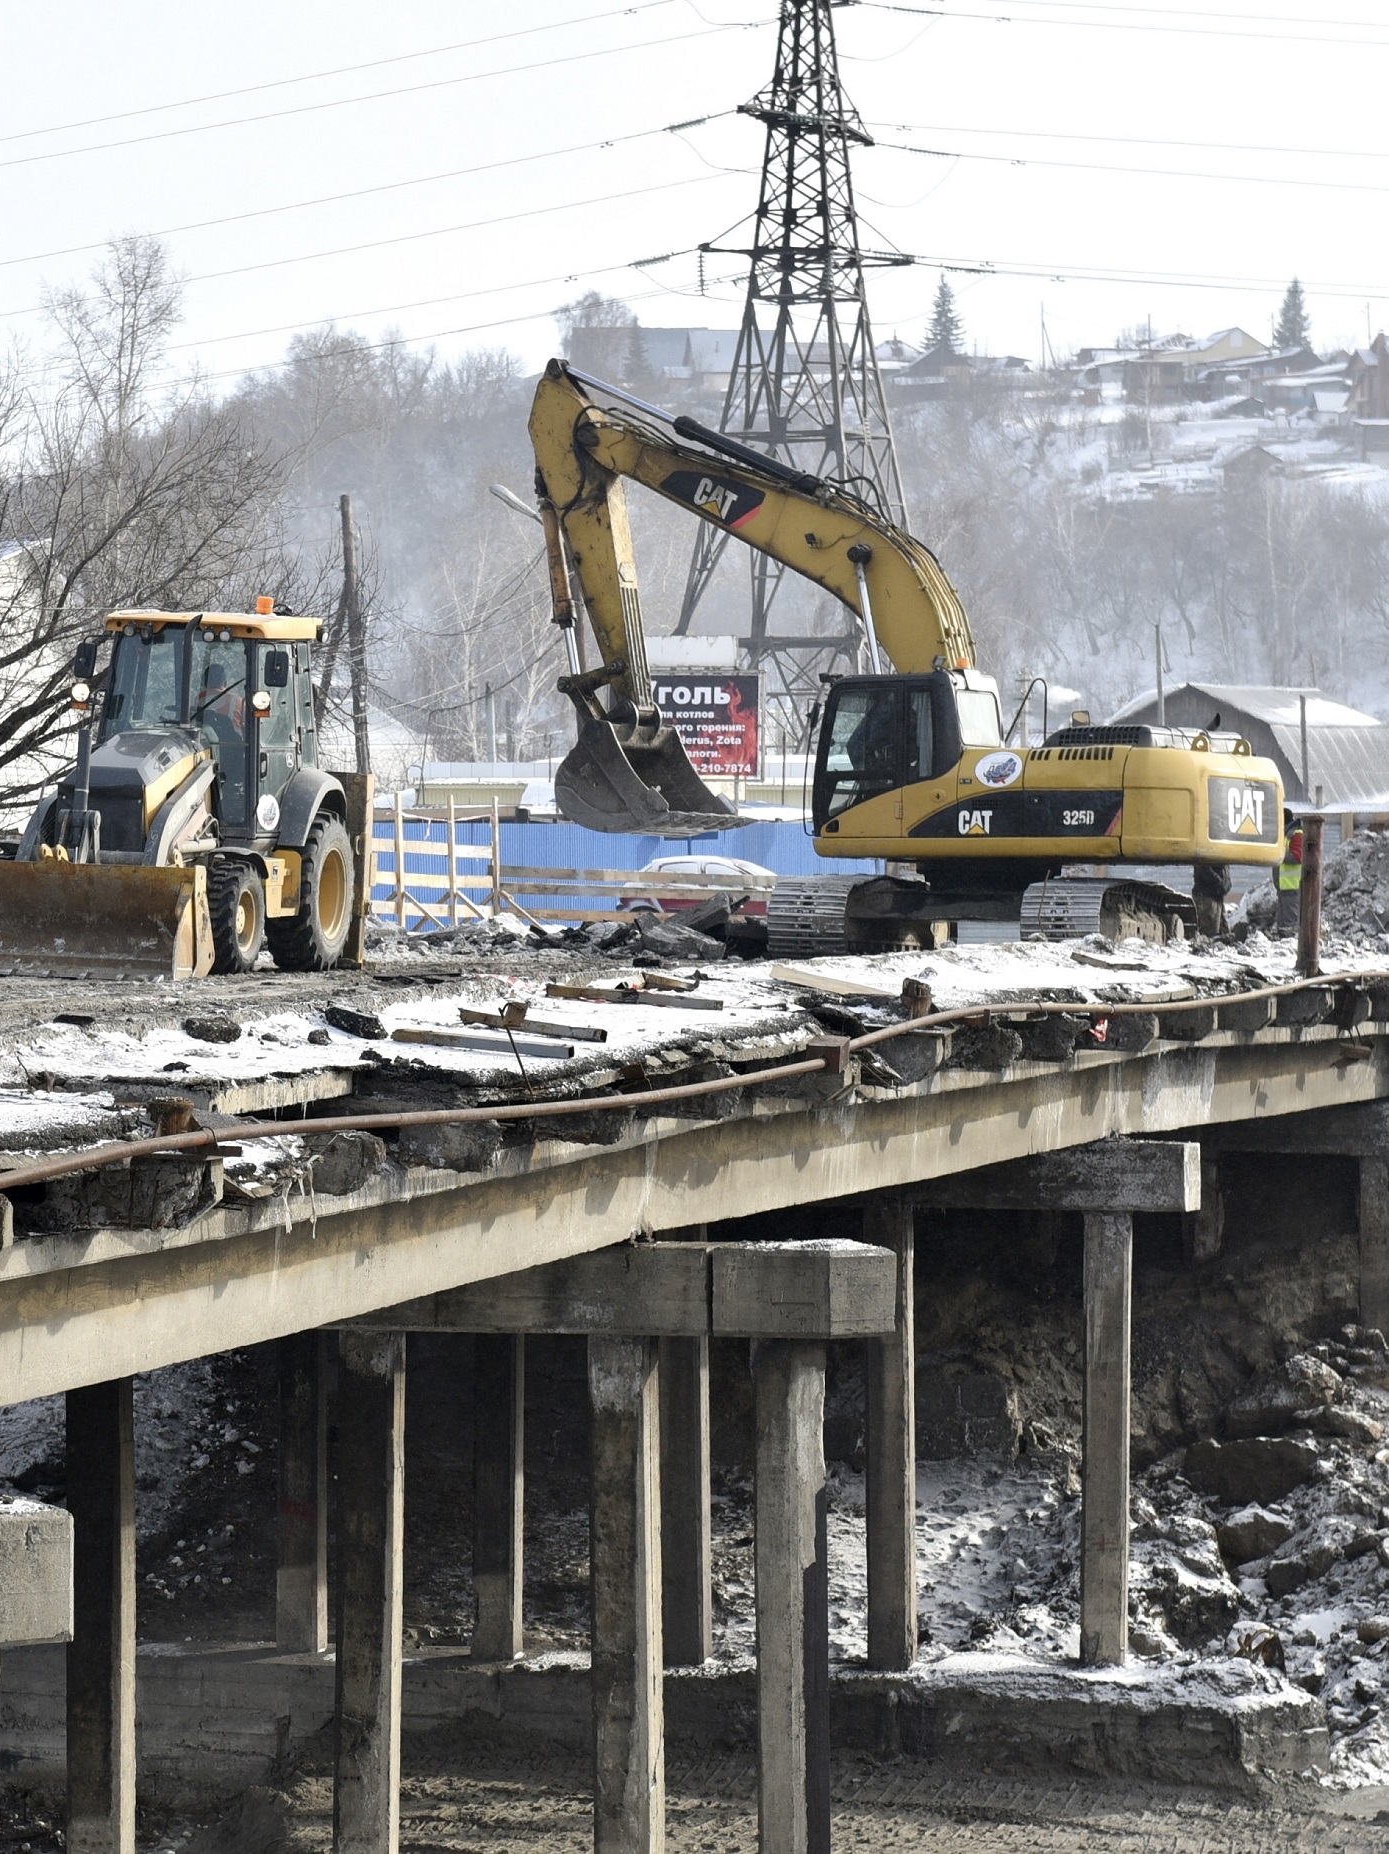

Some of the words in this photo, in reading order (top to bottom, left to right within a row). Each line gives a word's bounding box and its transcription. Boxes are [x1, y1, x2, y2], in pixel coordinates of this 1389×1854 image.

[694, 477, 738, 520] CAT
[661, 711, 673, 719] ля
[676, 711, 715, 719] котлов
[697, 724, 746, 734] горения:
[681, 735, 714, 747] derus,
[716, 735, 742, 745] Zota
[687, 750, 722, 758] алоги.
[1062, 810, 1095, 826] 325D
[1228, 787, 1265, 836] CAT
[958, 810, 993, 835] CAT
